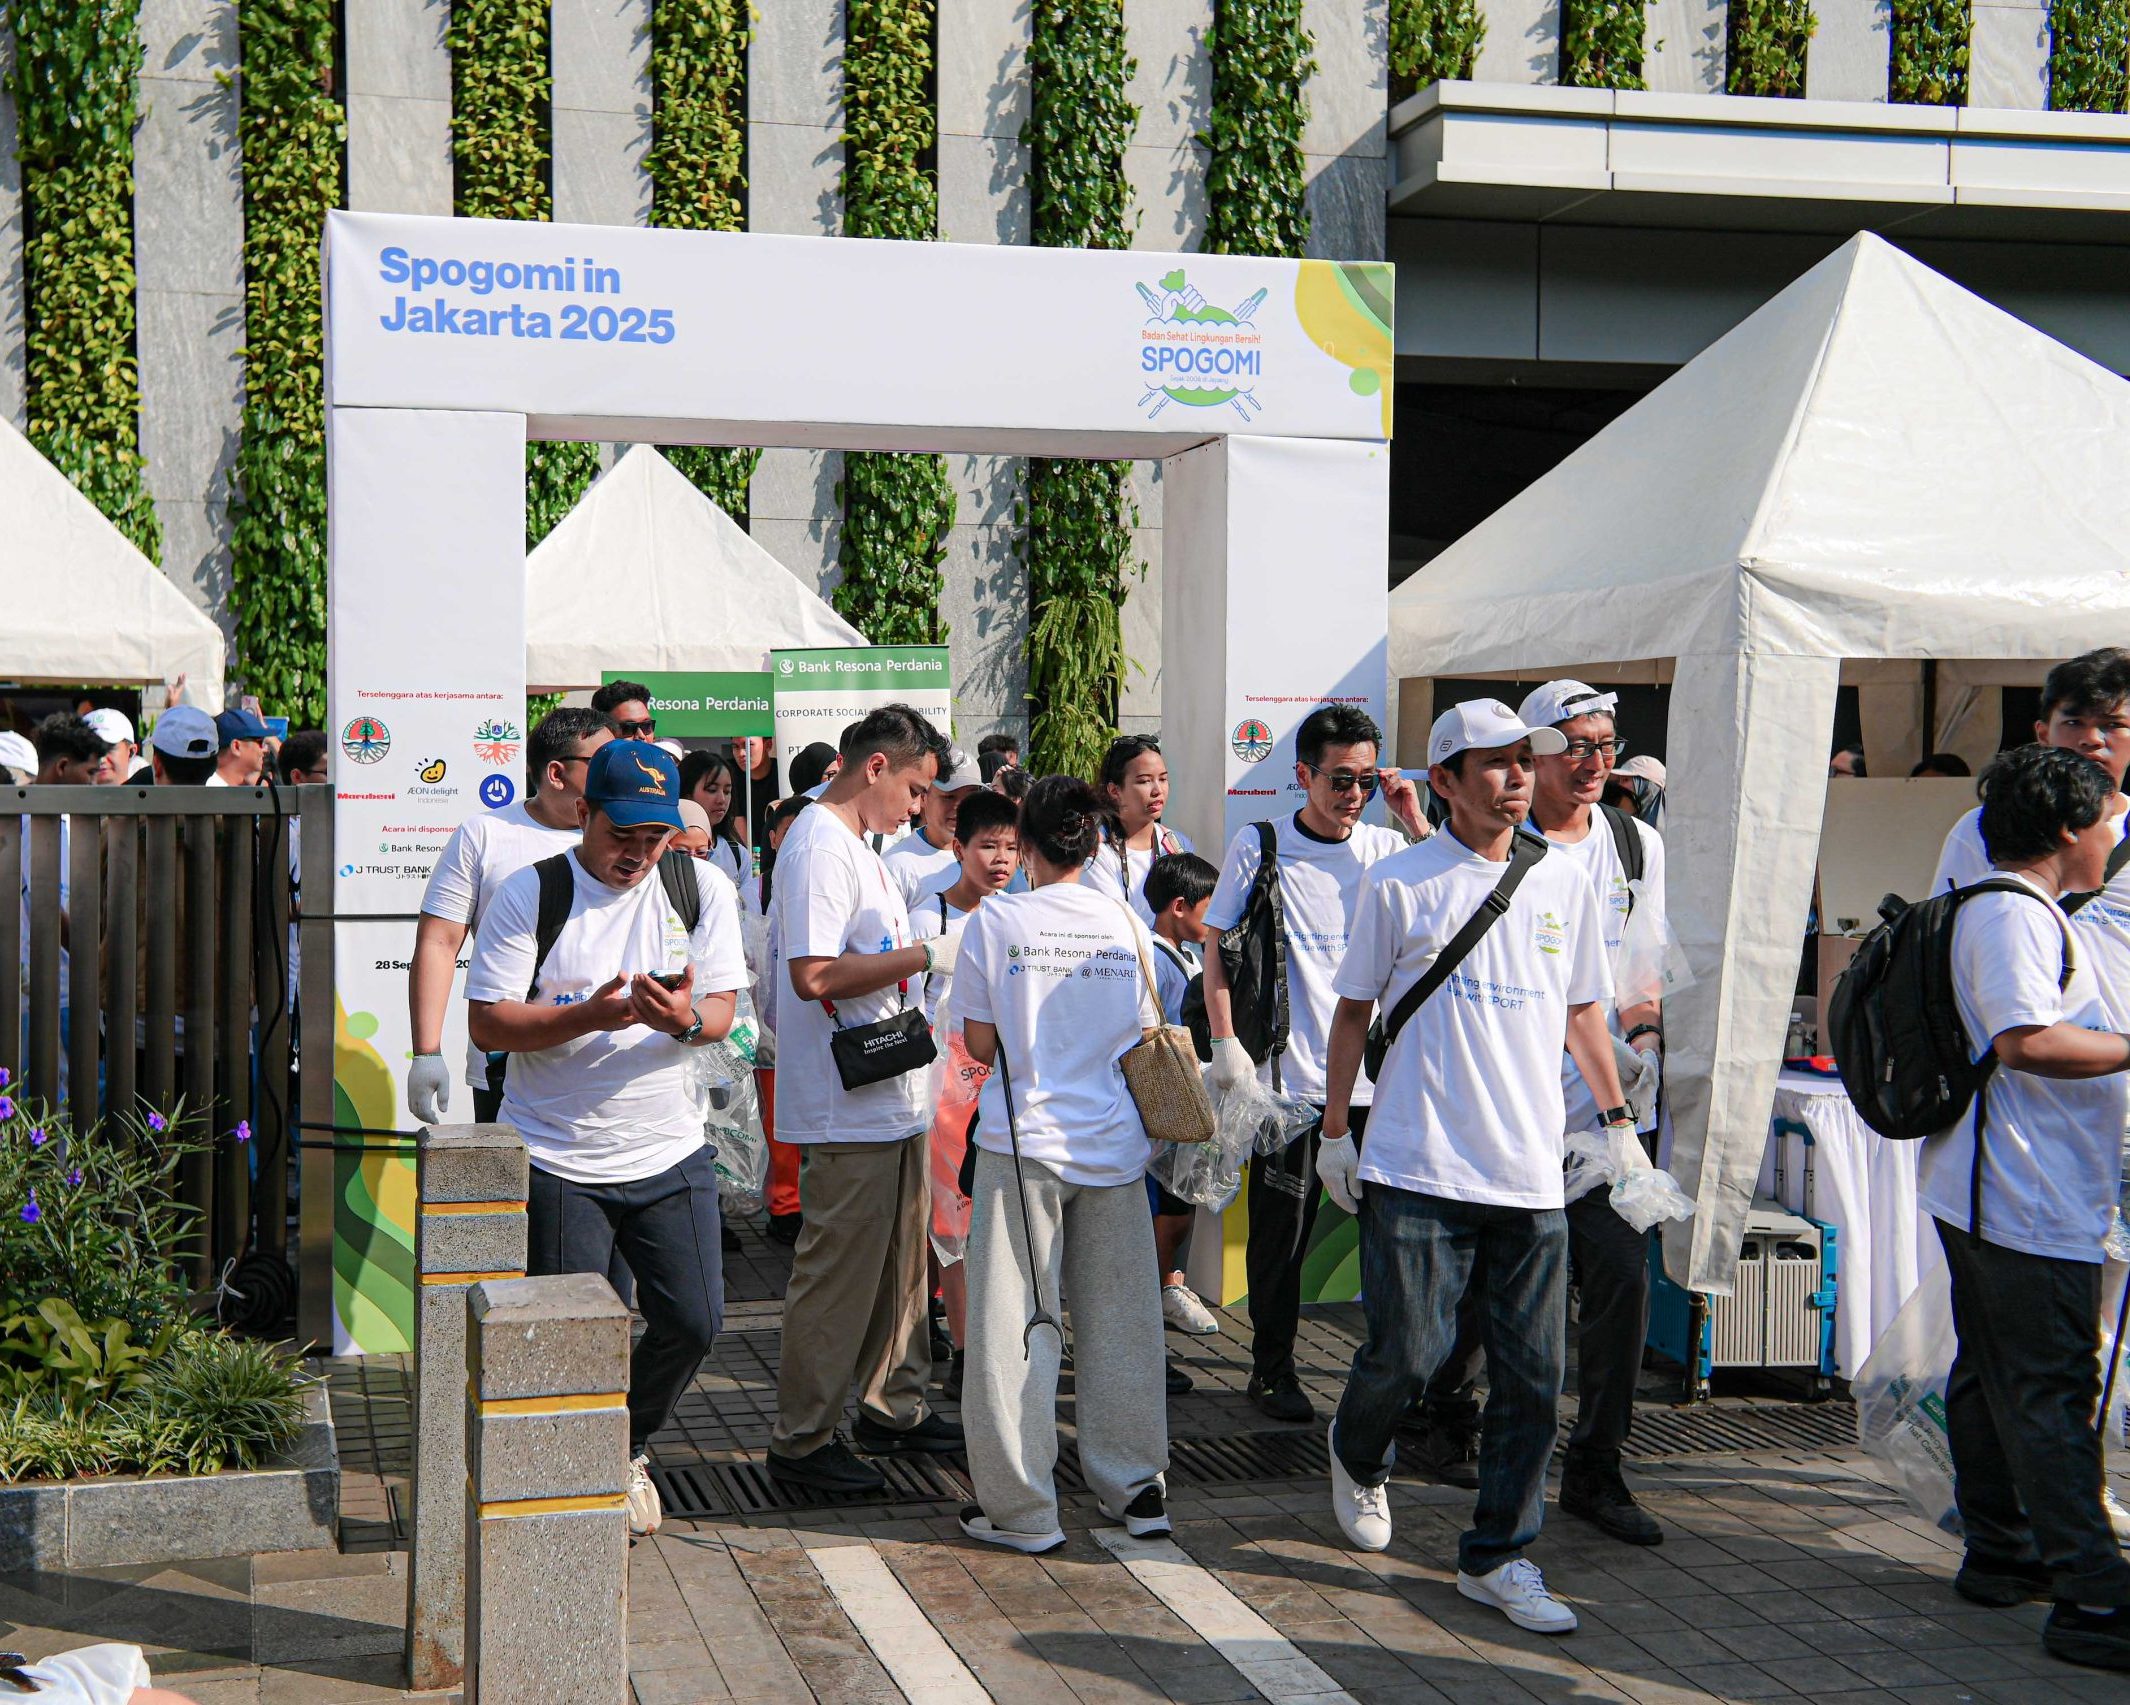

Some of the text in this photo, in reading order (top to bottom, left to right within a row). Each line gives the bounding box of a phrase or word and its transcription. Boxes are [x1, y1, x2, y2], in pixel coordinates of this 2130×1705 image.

[379, 246, 620, 295] Spogomi in
[379, 296, 675, 345] Jakarta 2025
[1141, 330, 1261, 345] Badan Sehat Lingkungan Bersih!
[1141, 346, 1261, 375] SPOGOMI
[799, 658, 942, 673] Bank Resona Perdania
[357, 691, 414, 700] Terselenggara
[434, 692, 475, 700] kerjasama
[1245, 695, 1293, 703] Terselenggara
[1310, 696, 1343, 704] kerjasama
[647, 696, 769, 710] Resona Perdania
[776, 709, 833, 718] CORPORATE
[836, 709, 868, 717] SOCIAL
[430, 787, 459, 797] delight
[381, 825, 406, 833] Acara
[418, 825, 458, 834] disponsor
[391, 844, 413, 853] Bank
[355, 866, 432, 874] J TRUST BANK
[1039, 930, 1057, 938] Acara
[1023, 946, 1137, 963] Bank Resona Perdania
[375, 960, 470, 970] 28 Sep 20
[1027, 965, 1051, 973] TRUST
[1053, 966, 1073, 974] BANK
[863, 1030, 904, 1049] HITACHI
